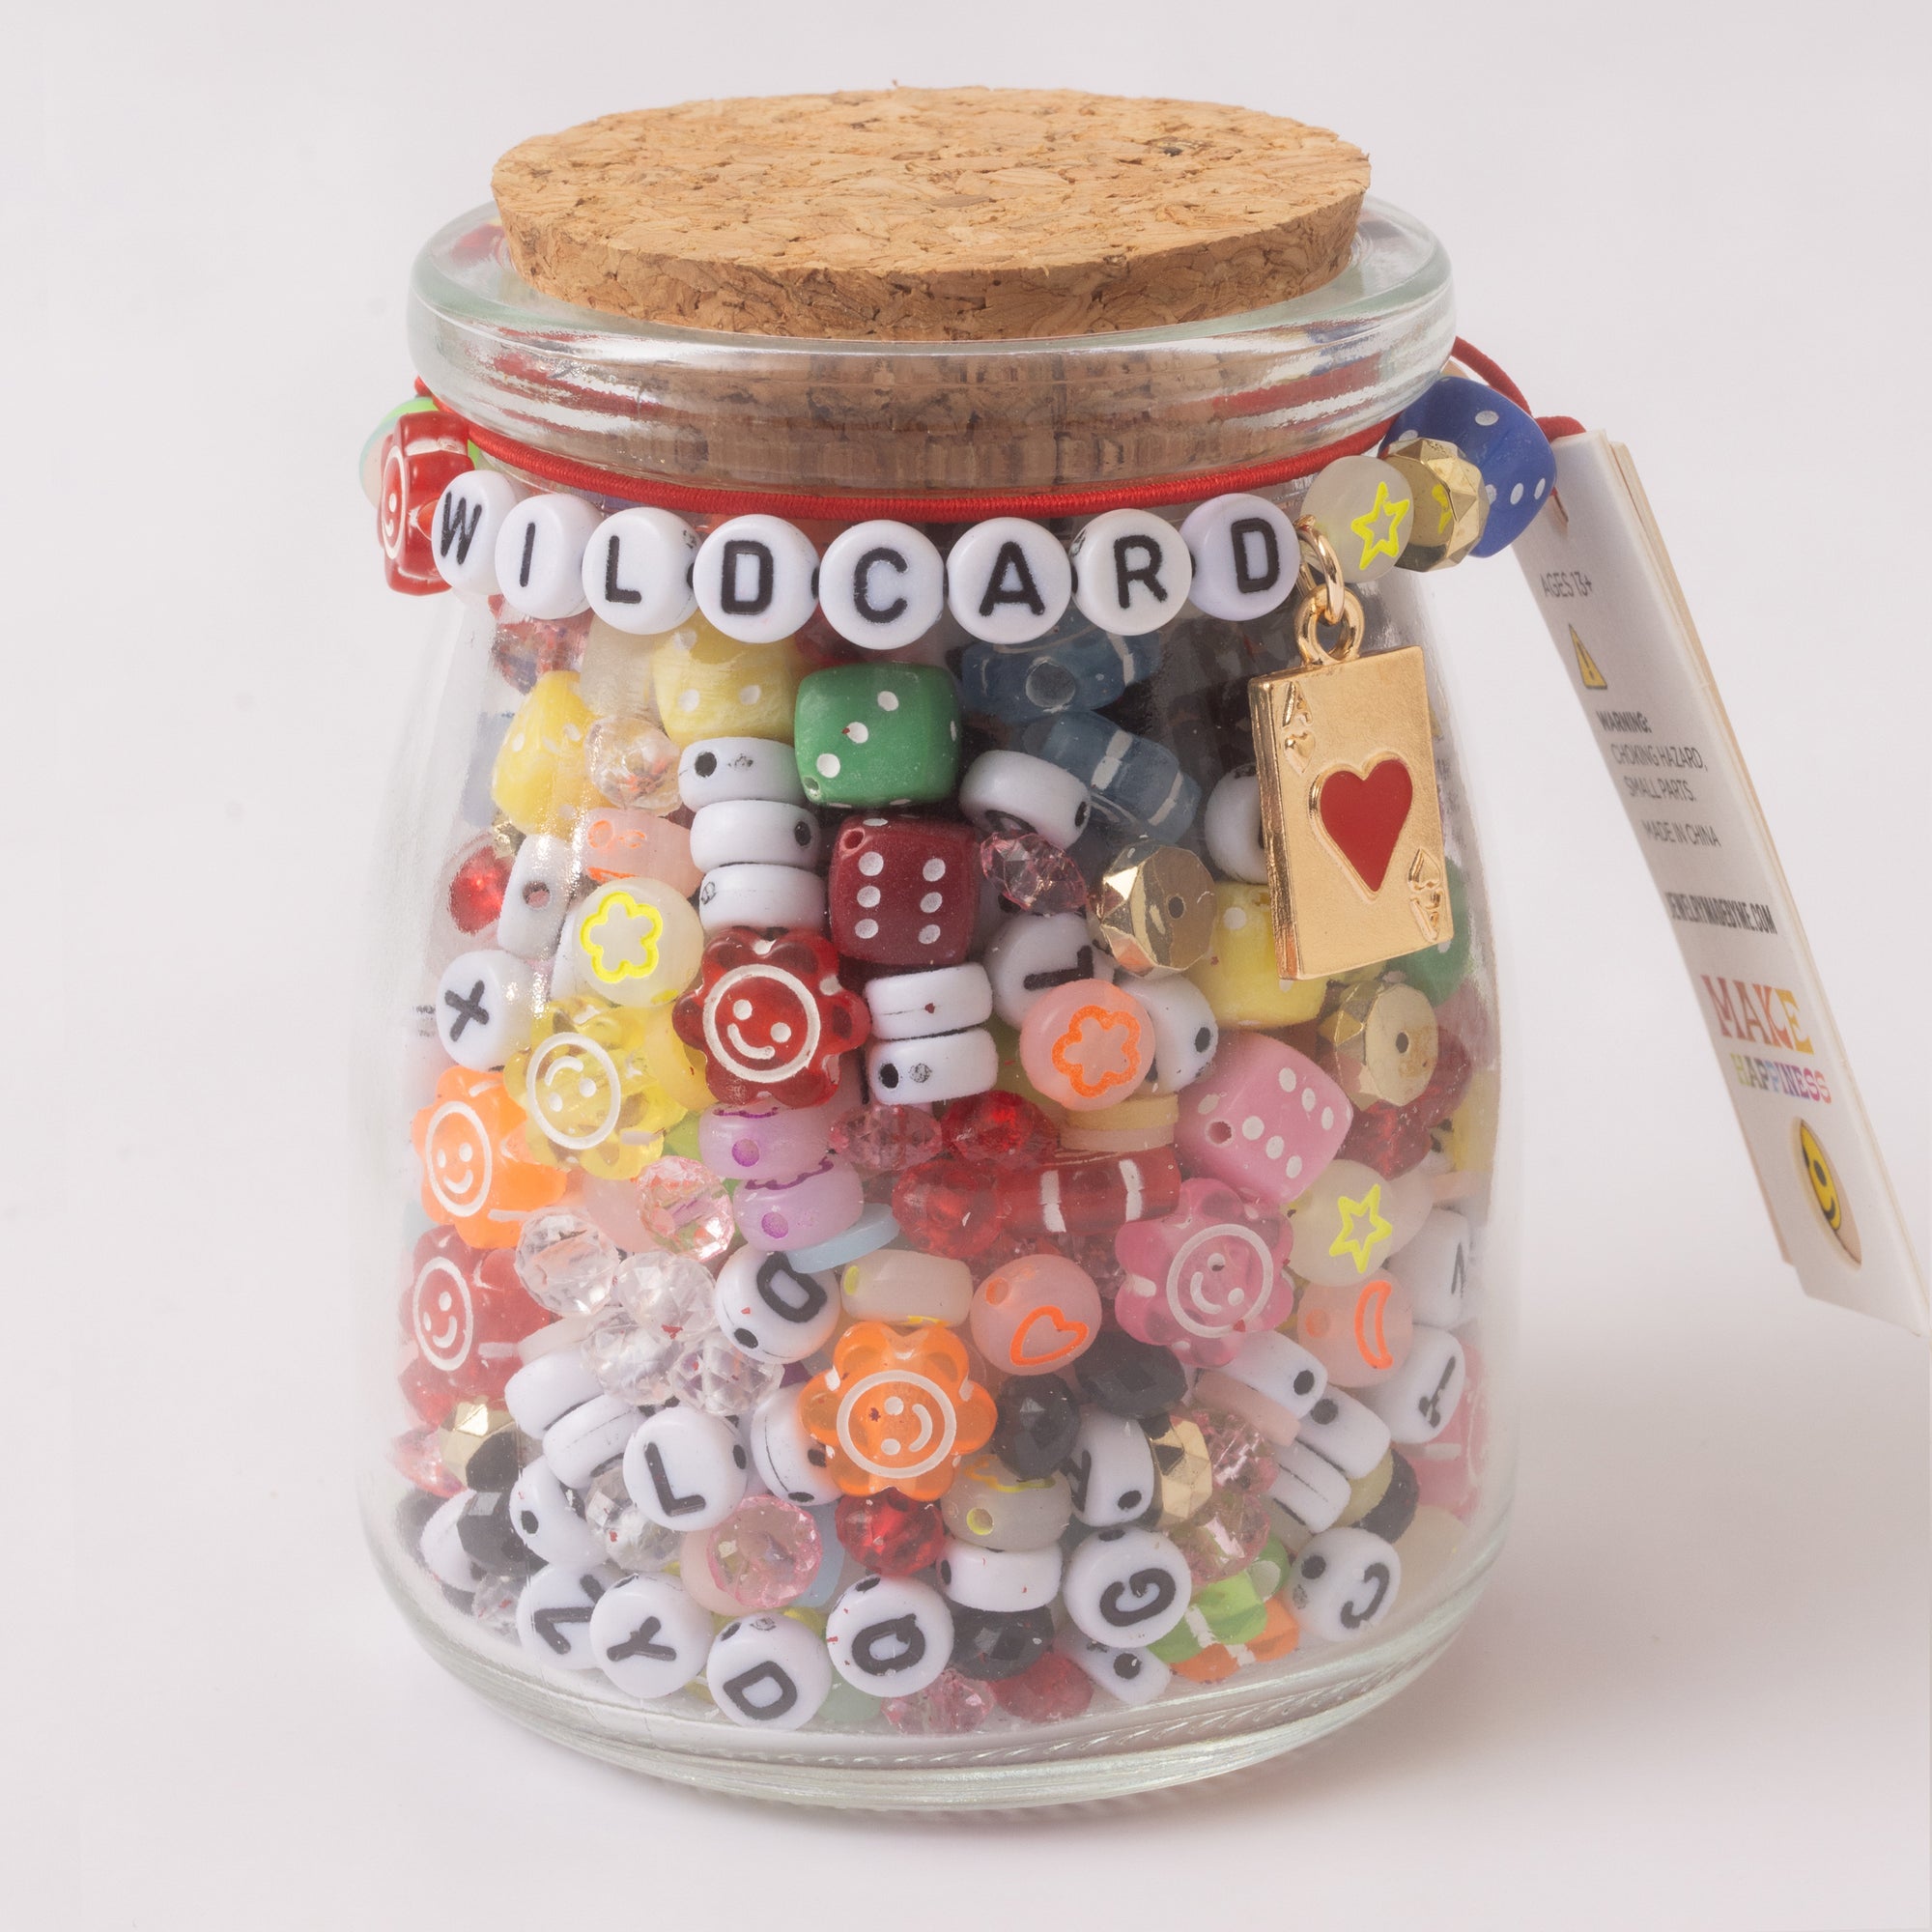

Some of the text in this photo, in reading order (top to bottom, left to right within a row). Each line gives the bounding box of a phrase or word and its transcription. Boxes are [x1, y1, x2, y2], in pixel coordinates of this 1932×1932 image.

[440, 491, 1281, 623] WILDCARD
[1540, 571, 1592, 598] AGES 13+
[1595, 711, 1652, 733] WARNING:
[1610, 743, 1708, 772] CHOKING HAZARD,
[1623, 776, 1696, 802] SMALL PARTS.
[1641, 819, 1721, 847] MADE IN CHINA
[1664, 892, 1777, 934] JEWELRYMADEBYME.COM
[444, 980, 490, 1042] X
[1701, 974, 1815, 1055] MAKE
[1730, 1053, 1832, 1104] HAPPINESS
[644, 1442, 706, 1517] L
[1098, 1567, 1177, 1628] G
[607, 1616, 677, 1662] Y
[723, 1660, 798, 1720] D
